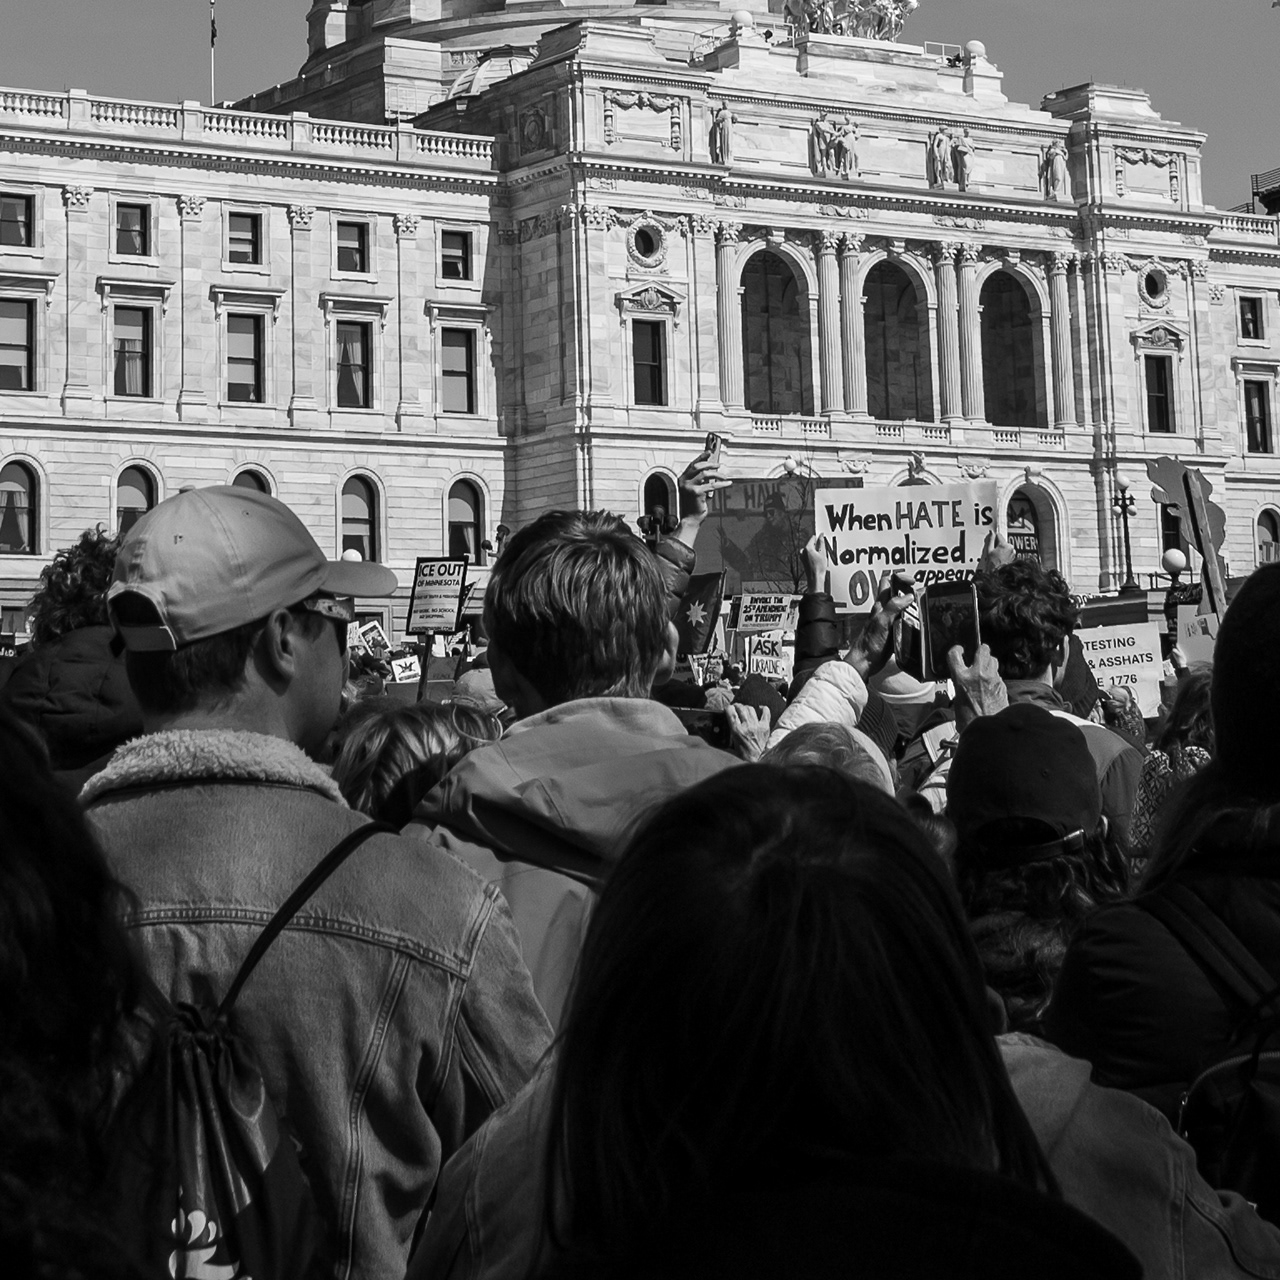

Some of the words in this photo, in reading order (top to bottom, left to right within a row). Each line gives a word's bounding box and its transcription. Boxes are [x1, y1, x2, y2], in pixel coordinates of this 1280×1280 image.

[825, 503, 892, 532] When
[895, 500, 965, 530] HATE
[974, 503, 993, 526] is
[418, 564, 435, 577] ICE
[437, 563, 464, 577] OUT
[752, 639, 780, 657] ASK
[1098, 652, 1154, 668] ASSHATS
[1108, 673, 1138, 686] 1776
